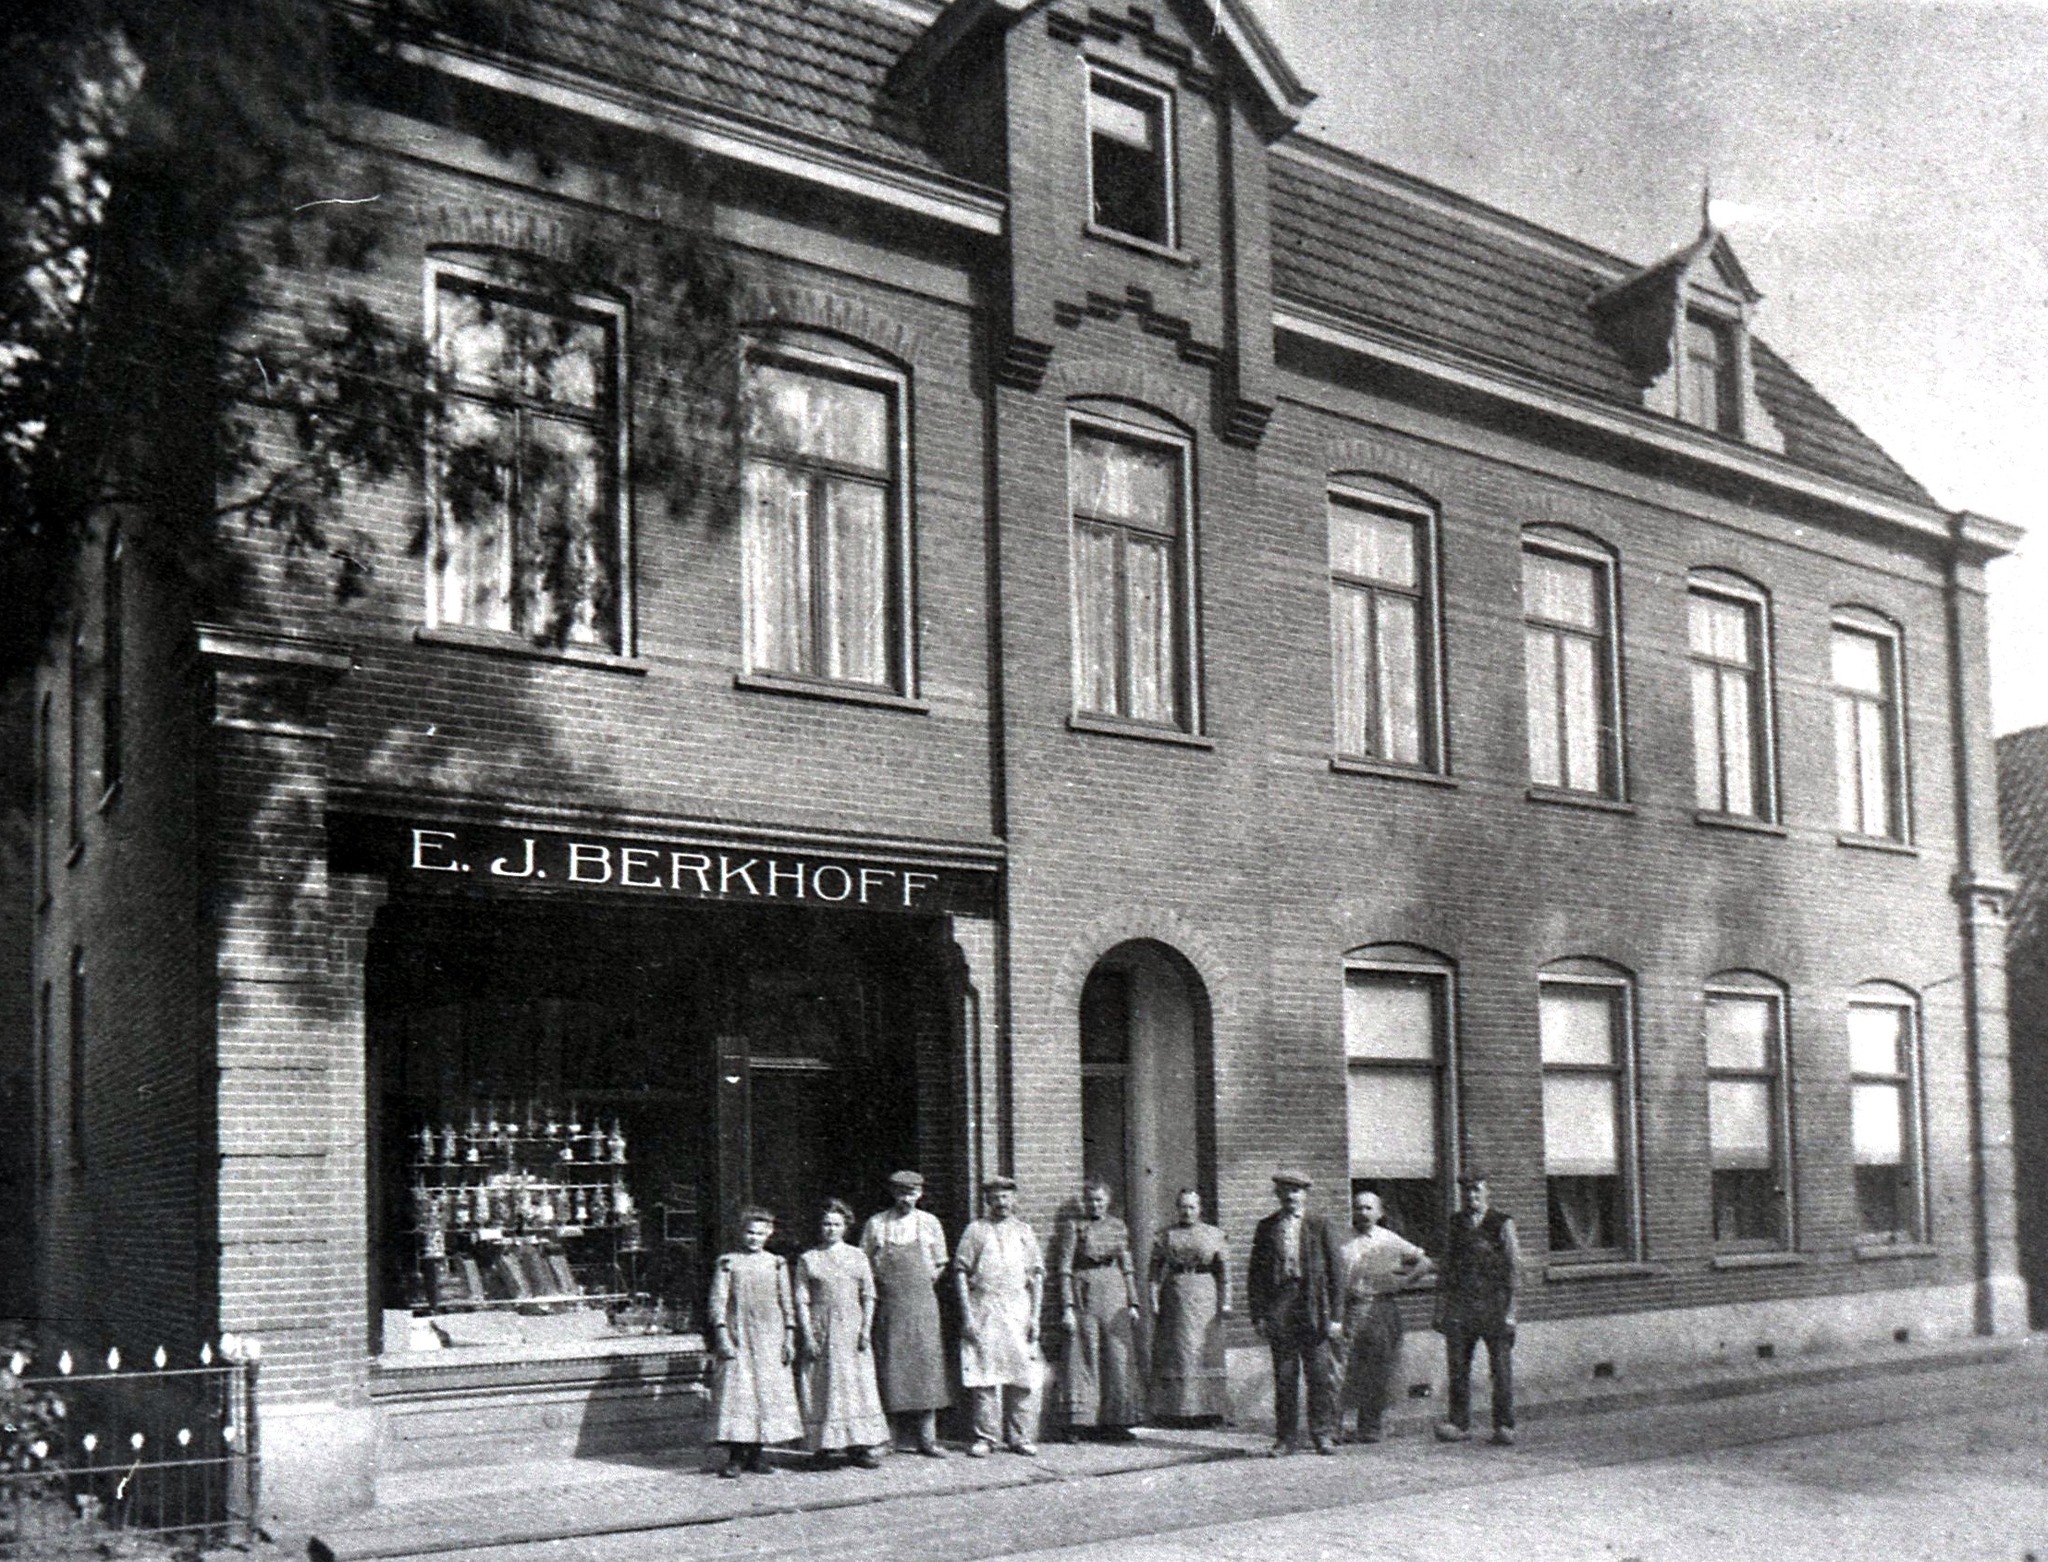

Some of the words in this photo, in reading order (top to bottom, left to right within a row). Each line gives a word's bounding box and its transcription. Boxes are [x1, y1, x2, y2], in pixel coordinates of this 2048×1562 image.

[411, 828, 471, 873] E.
[490, 838, 547, 879] J.
[568, 842, 939, 906] BERKHOFF
